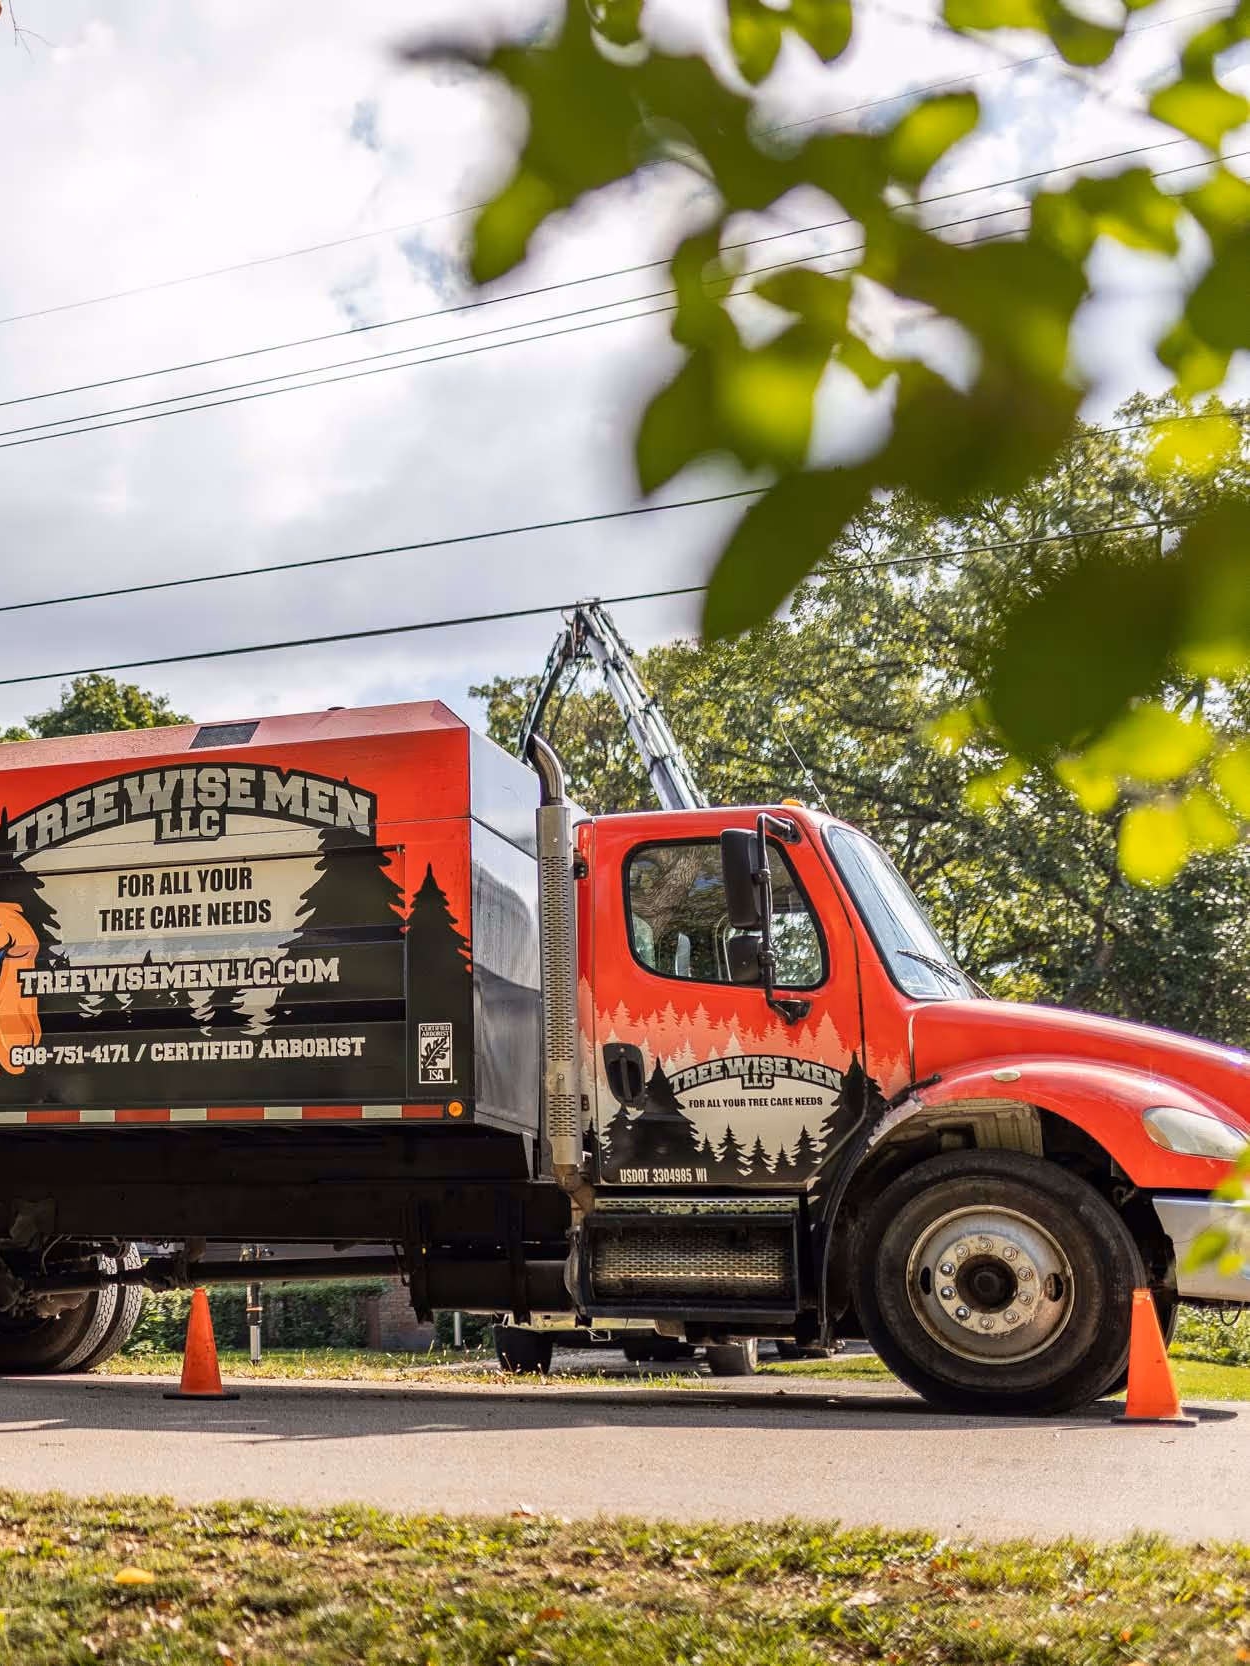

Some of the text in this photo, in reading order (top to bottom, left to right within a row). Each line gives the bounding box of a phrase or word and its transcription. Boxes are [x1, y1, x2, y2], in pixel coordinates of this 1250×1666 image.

[8, 767, 370, 859] TREE WISE MEN
[161, 809, 220, 840] LLC
[118, 867, 252, 897] FOR ALL YOUR
[99, 899, 271, 931] TREE CARE NEEDS
[20, 958, 340, 996] TREEWISEMENLLC.COM
[11, 1045, 129, 1065] 608-751-4171
[151, 1041, 253, 1062] CERTIFIED
[258, 1037, 366, 1060] ARBORIST
[429, 1069, 444, 1080] ISA
[670, 1056, 843, 1093] TREE WISE MEN
[743, 1075, 772, 1087] LLC
[689, 1097, 823, 1108] FOR ALL YOUR TREE CARE NEEDS
[620, 1168, 707, 1183] USDOT 3304985 WI
